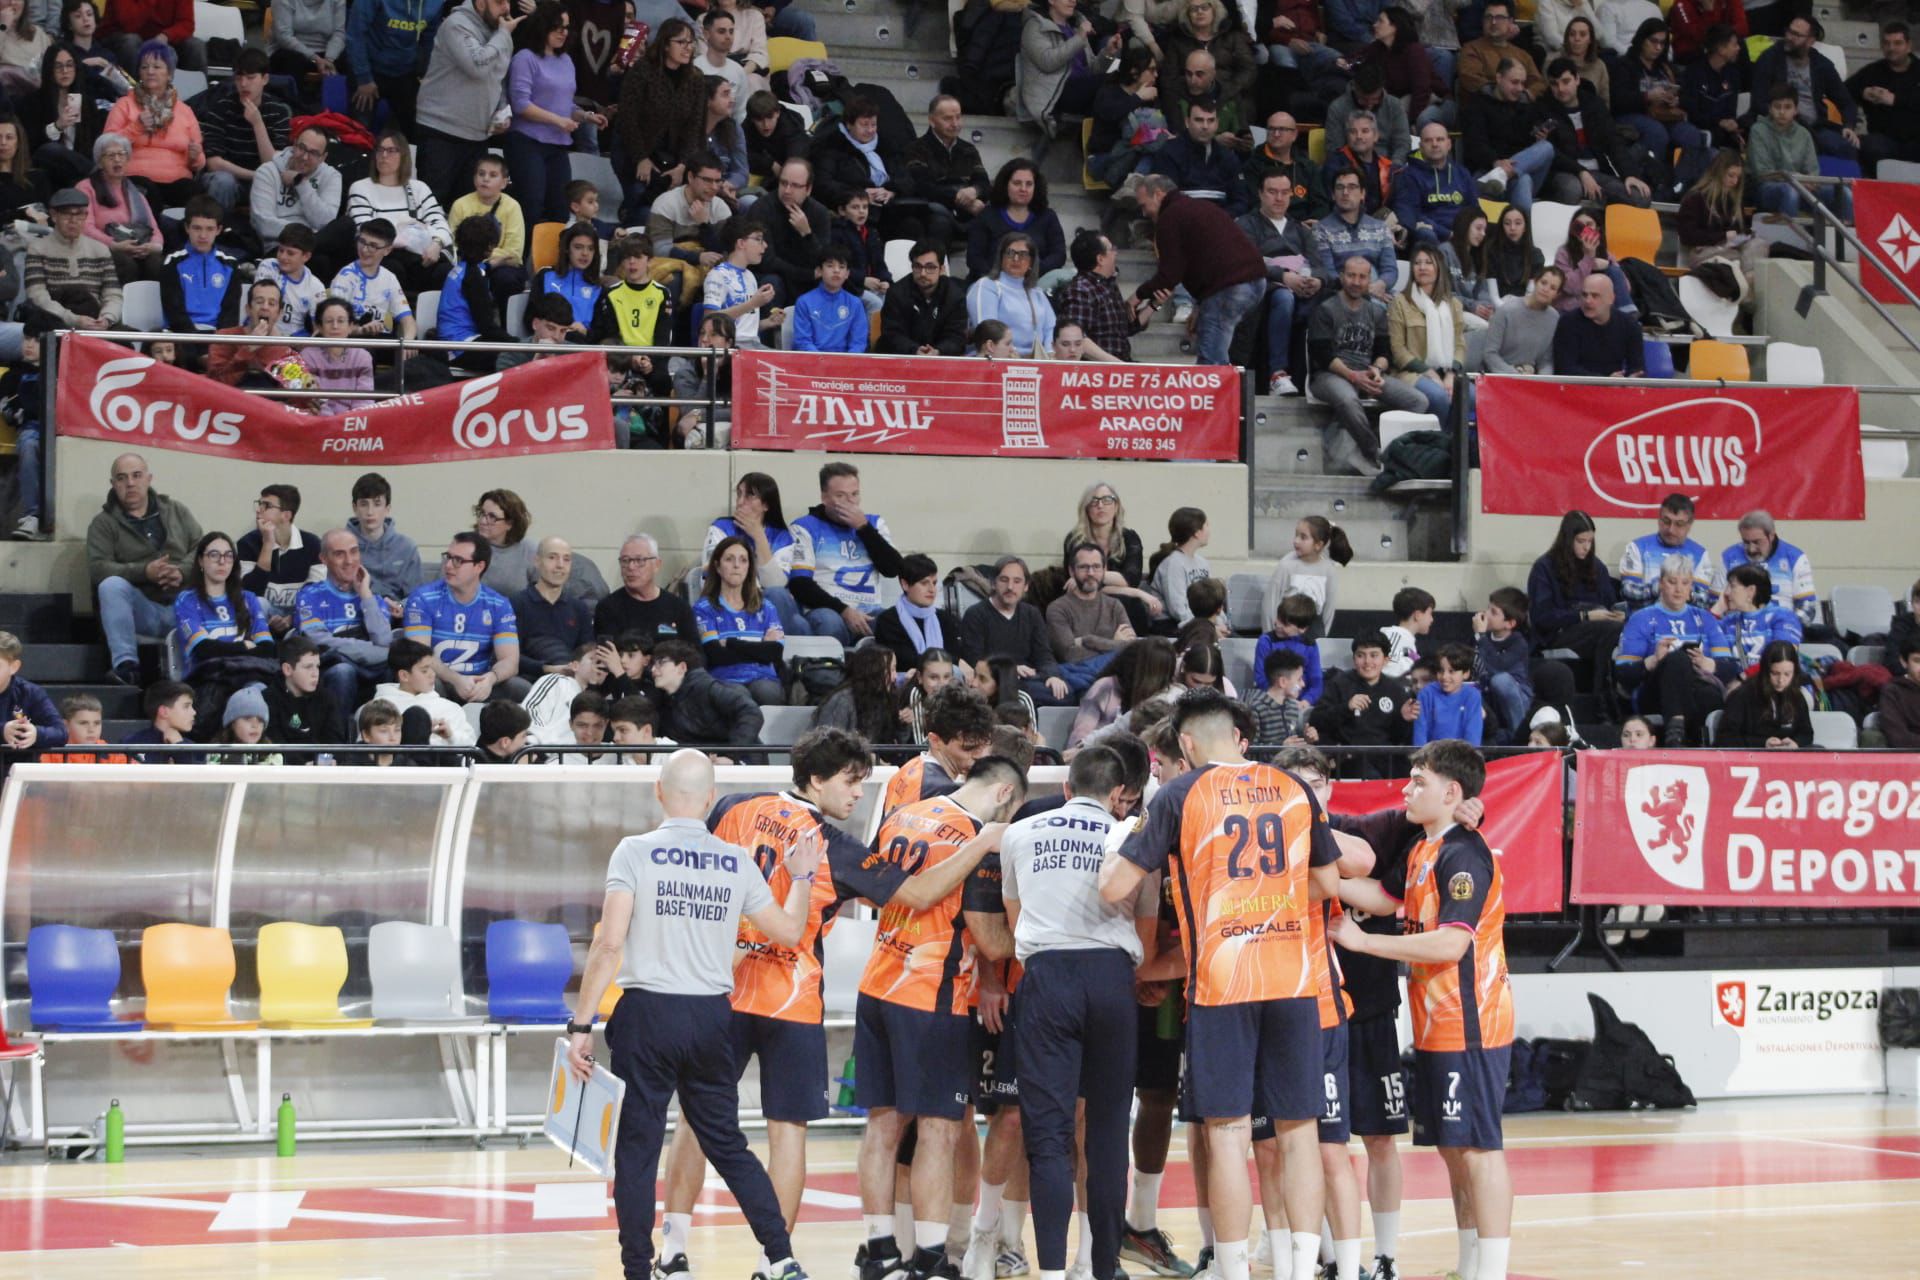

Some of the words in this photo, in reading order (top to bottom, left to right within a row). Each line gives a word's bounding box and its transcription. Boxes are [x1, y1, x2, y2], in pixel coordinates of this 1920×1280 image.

[631, 308, 641, 328] 3
[811, 380, 855, 392] montajes
[858, 380, 907, 394] eléctricos
[1061, 372, 1104, 388] MAS
[1109, 373, 1135, 388] DE
[1140, 374, 1160, 389] 75
[1164, 371, 1222, 389] AÑOS
[1060, 394, 1087, 410] AL
[1091, 395, 1184, 411] SERVICIO
[1190, 395, 1215, 411] DE
[343, 416, 368, 432] EN
[1099, 413, 1183, 432] ARAGÓN
[321, 437, 384, 452] FORMA
[1107, 437, 1129, 450] 976
[1131, 437, 1153, 450] 526
[1155, 438, 1176, 451] 345
[1615, 433, 1748, 487] BELLVIS
[840, 540, 860, 561] 42
[216, 605, 230, 622] 8
[343, 602, 357, 619] 8
[454, 613, 466, 633] 8
[735, 617, 746, 631] 8
[1730, 766, 1920, 838] Zaragoz
[1034, 838, 1104, 857] BALONMA
[1223, 812, 1286, 879] 29
[1033, 854, 1067, 873] BASE
[1727, 833, 1920, 893] DEPORT
[657, 879, 732, 903] BALONMANO
[655, 899, 686, 916] BASE
[1220, 920, 1303, 938] GONZALEZ
[1757, 984, 1879, 1021] Zaragoza
[982, 1050, 994, 1075] 2
[1323, 1072, 1338, 1100] 6
[1380, 1072, 1405, 1100] 15
[1447, 1071, 1461, 1098] 7
